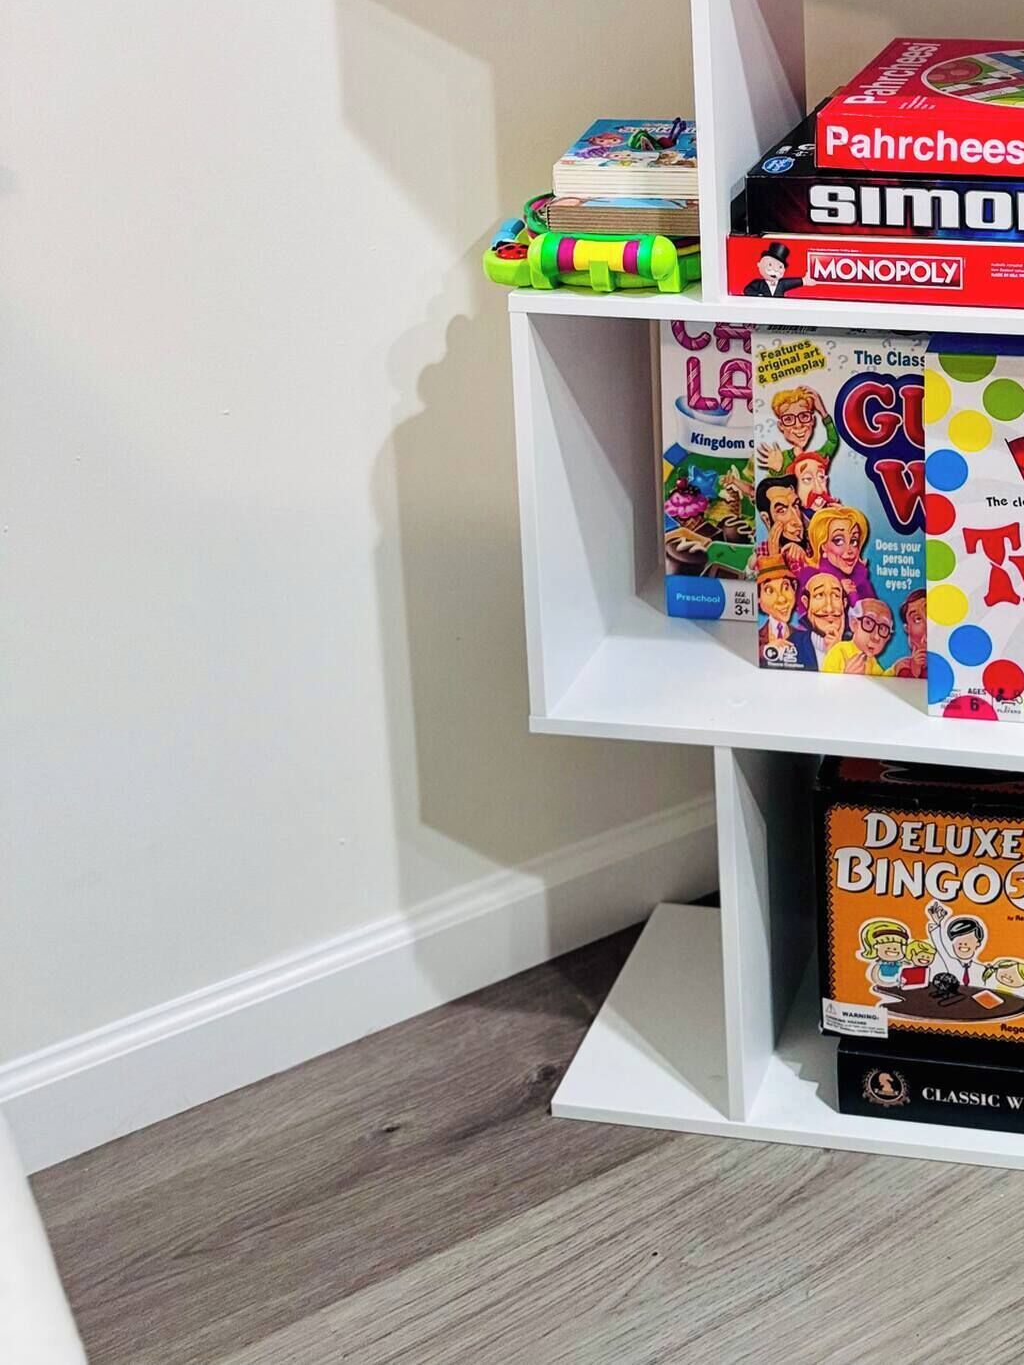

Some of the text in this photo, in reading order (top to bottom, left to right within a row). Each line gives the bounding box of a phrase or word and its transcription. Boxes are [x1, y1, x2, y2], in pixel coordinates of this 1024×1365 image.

[842, 42, 941, 104] Pahrcheesi
[813, 257, 959, 284] MONOPOLY
[760, 339, 812, 362] Features
[853, 350, 925, 367] The Class
[757, 347, 821, 374] original art
[757, 356, 826, 384] & gameplay
[690, 432, 745, 451] Kingdom
[985, 496, 1009, 508] The
[875, 539, 921, 554] Does your
[882, 554, 915, 566] person
[876, 564, 921, 578] have blue
[885, 578, 913, 591] eyes?
[676, 592, 721, 603] Preschool
[734, 605, 750, 616] 3+
[864, 812, 1024, 861] DELUXE
[834, 847, 1003, 905] BINGO
[921, 1086, 1001, 1108] CLASSIC
